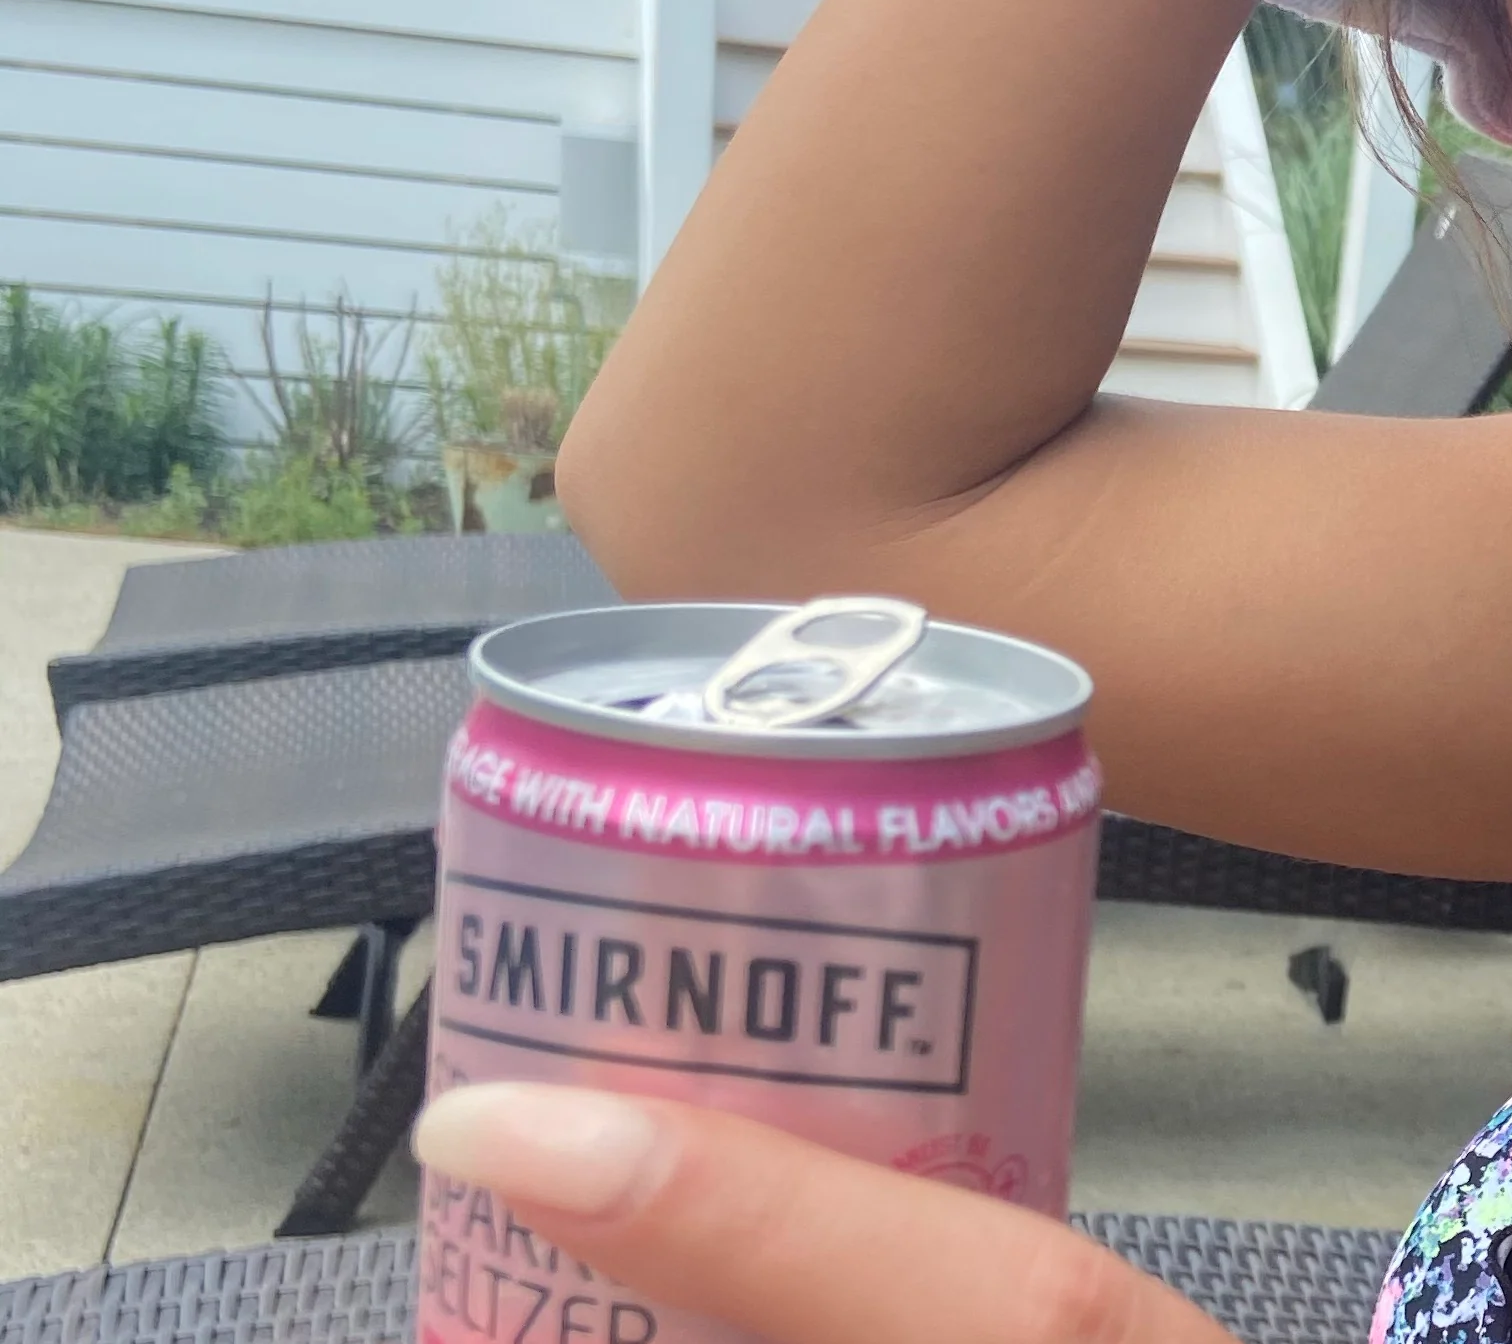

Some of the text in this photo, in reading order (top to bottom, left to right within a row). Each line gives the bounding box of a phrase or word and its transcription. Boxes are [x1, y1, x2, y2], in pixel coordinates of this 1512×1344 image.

[511, 767, 615, 836] WITH
[619, 788, 863, 855] NATURAL
[878, 786, 1059, 854] FLAVORS
[458, 913, 924, 1053] SMIRNOFF
